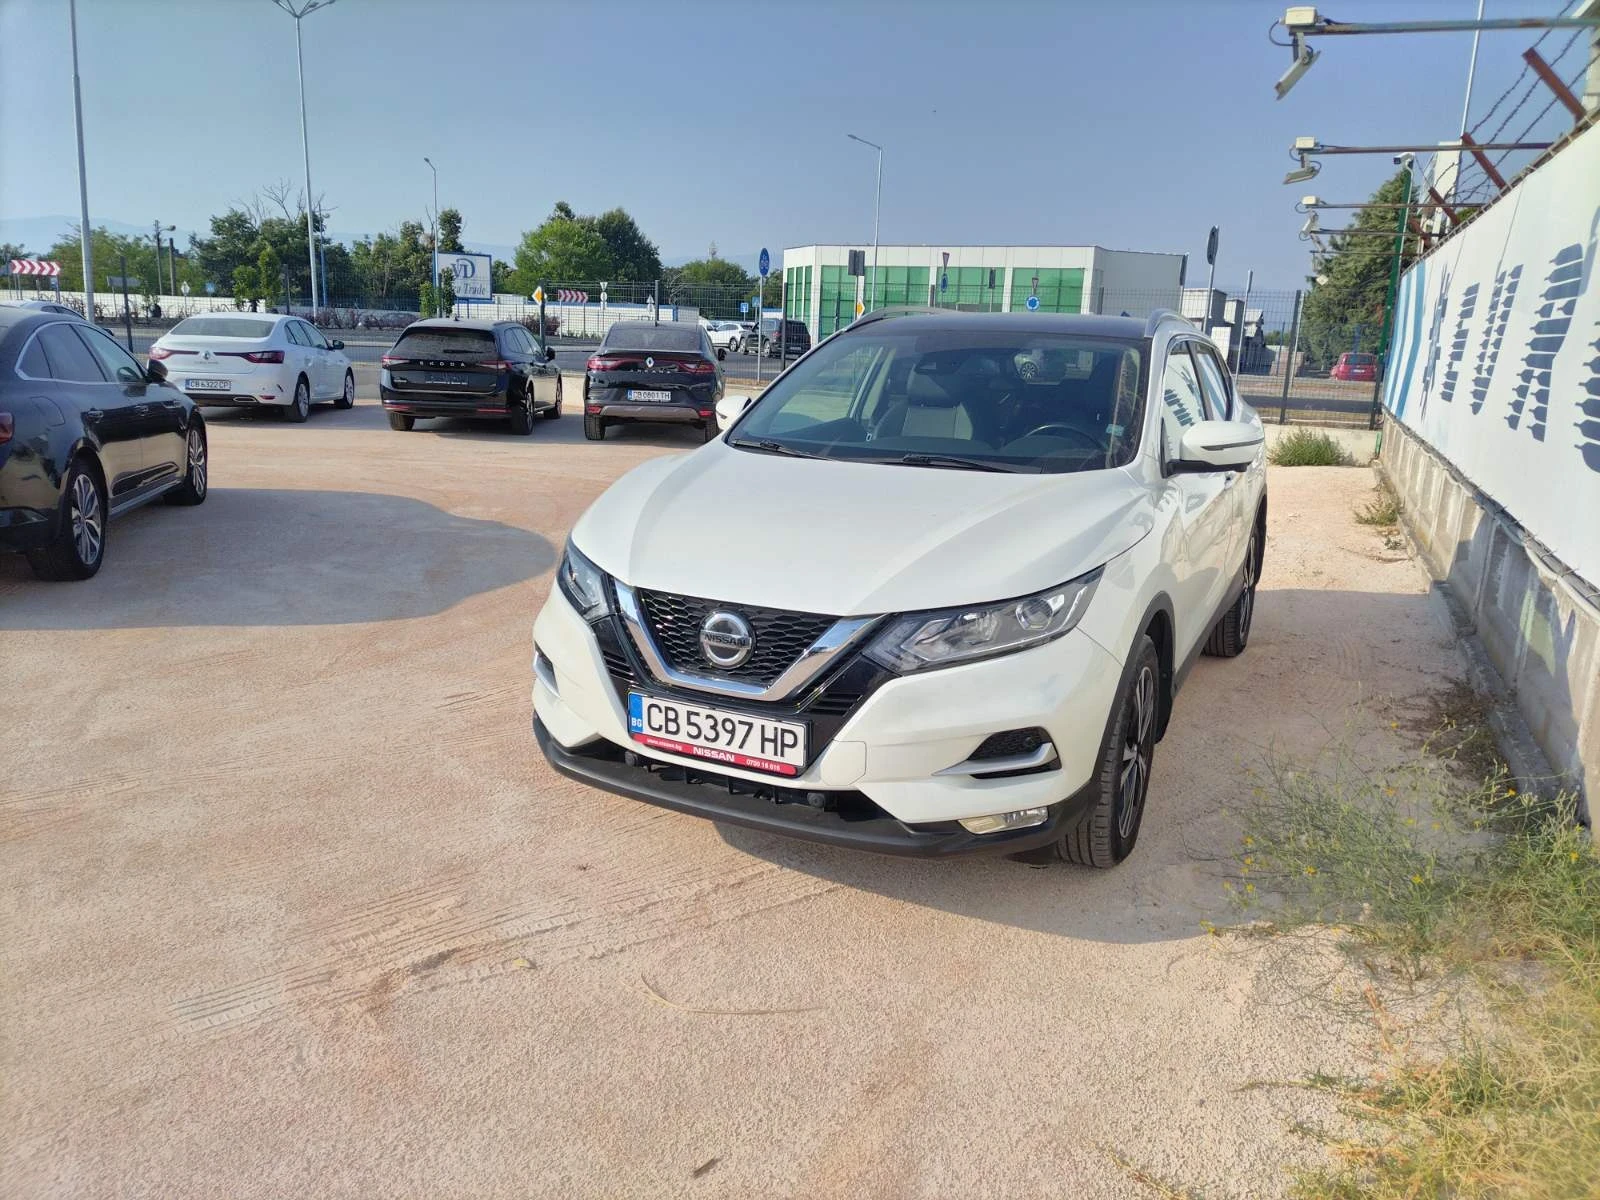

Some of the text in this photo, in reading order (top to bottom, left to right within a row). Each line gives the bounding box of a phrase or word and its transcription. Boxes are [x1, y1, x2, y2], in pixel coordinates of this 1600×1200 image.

[464, 283, 486, 296] Trade
[703, 633, 748, 647] NISSAN
[631, 717, 643, 728] BG
[647, 703, 799, 758] CB 5397 HP
[693, 747, 736, 763] NISSAN
